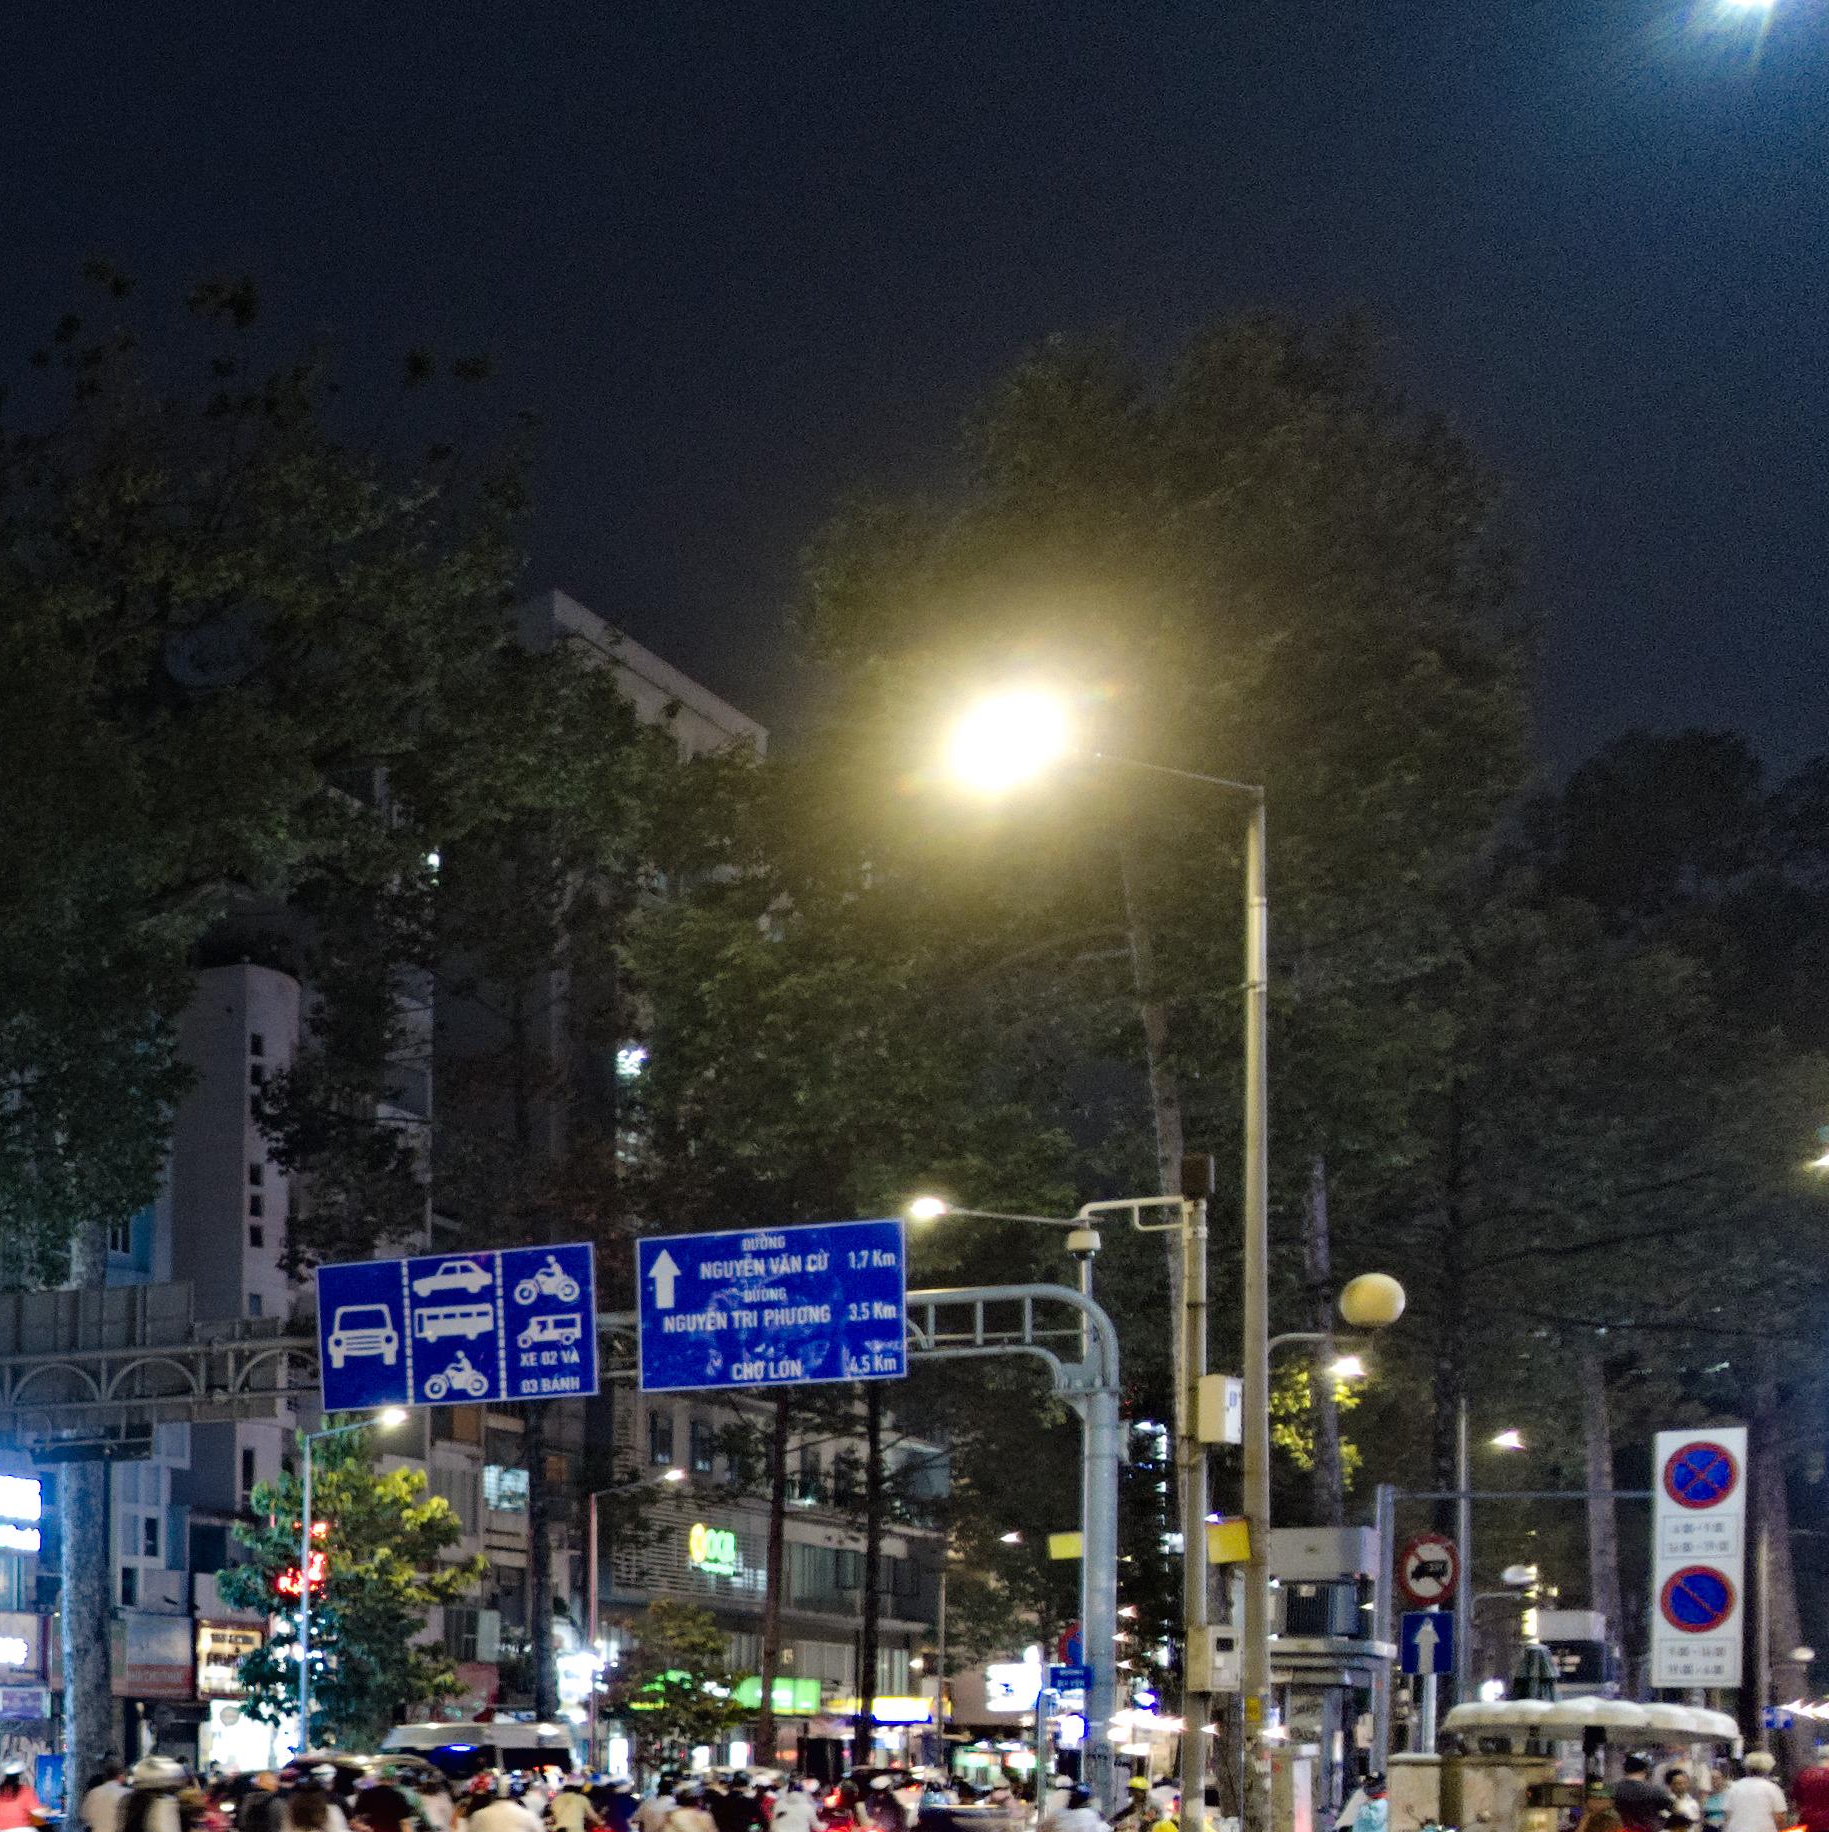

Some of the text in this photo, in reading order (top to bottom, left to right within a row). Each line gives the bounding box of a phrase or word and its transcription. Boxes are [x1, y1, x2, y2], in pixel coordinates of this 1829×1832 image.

[872, 1248, 896, 1268] Km
[873, 1301, 897, 1319] Km
[520, 1352, 538, 1367] XE
[541, 1350, 558, 1365] 02
[873, 1354, 897, 1371] Km
